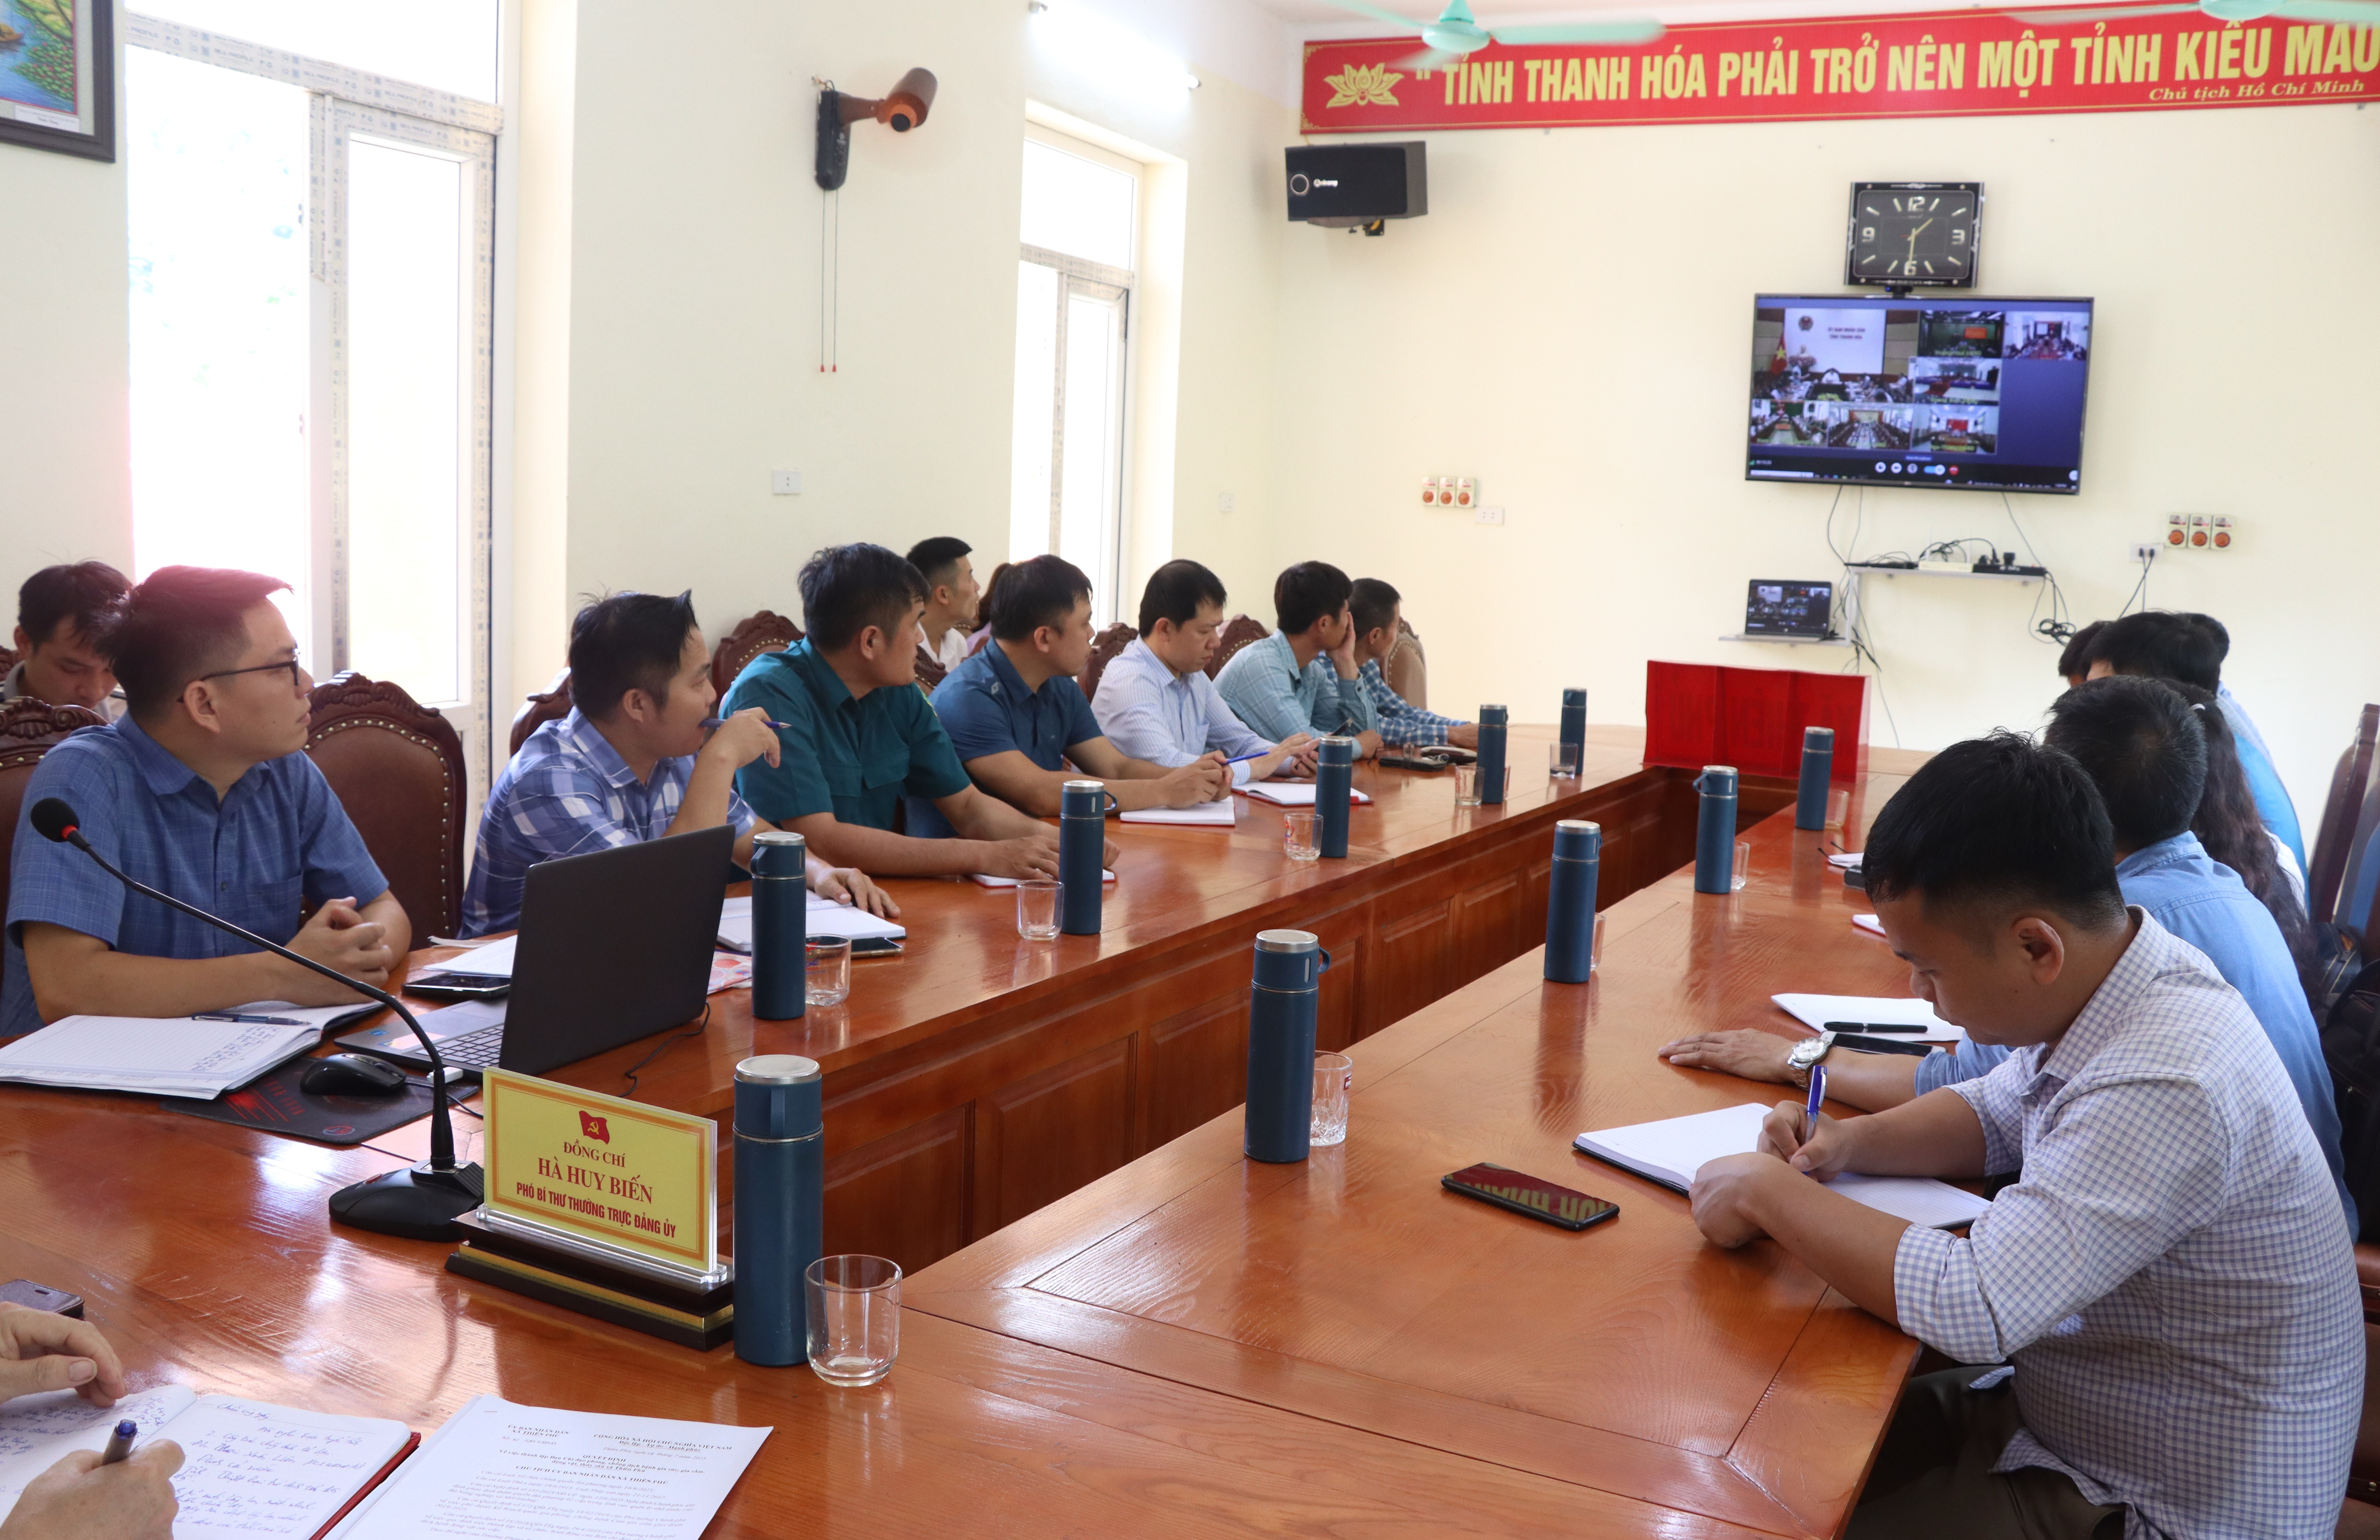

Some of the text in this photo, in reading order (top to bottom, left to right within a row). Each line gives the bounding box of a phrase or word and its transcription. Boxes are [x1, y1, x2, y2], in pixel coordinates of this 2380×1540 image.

[1524, 56, 1630, 104] THANH
[1640, 45, 1707, 99] HÓA
[1718, 36, 1799, 97] PHẢI
[1810, 32, 1880, 94] TRỞ
[1887, 35, 1965, 92] NÊN
[1978, 30, 2059, 98] MỘT
[2071, 21, 2161, 85] TỈNH
[2149, 79, 2364, 101] Chủ tịch Hồ Chí Minh
[1908, 196, 1925, 212] 12
[1862, 227, 1875, 242] 9
[1952, 229, 1965, 245] 3
[1904, 261, 1917, 276] 6
[563, 1139, 625, 1168] ĐỒNG CHÍ
[537, 1157, 653, 1204] HÀ HUY BIẾN
[517, 1182, 676, 1238] PHÓ BÍ THƯ THƯỜNG TRỰC ĐẢNG ỦY
